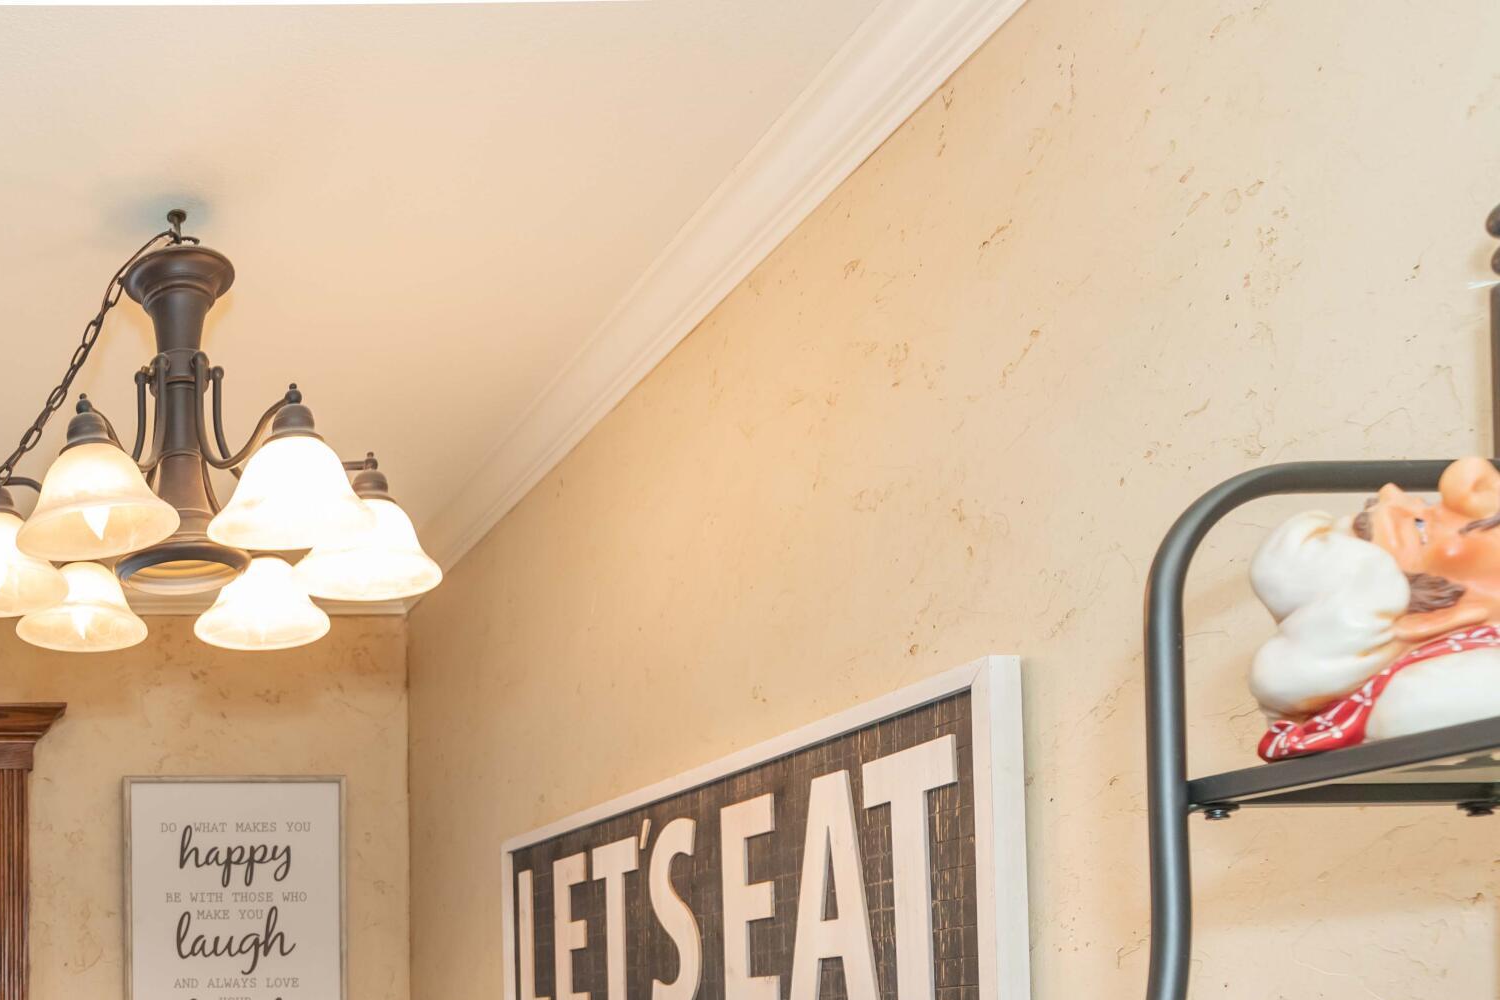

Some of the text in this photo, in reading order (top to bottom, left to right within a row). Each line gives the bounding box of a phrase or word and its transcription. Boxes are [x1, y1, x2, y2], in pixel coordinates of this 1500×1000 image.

[160, 822, 311, 833] DO WHAT MAKES YOU
[179, 825, 292, 888] happy
[166, 892, 307, 903] BE WITH THOSE WHO
[197, 909, 264, 920] MAKE YOU
[176, 906, 297, 975] laugh
[174, 978, 300, 989] AND ALWAYS LOVE
